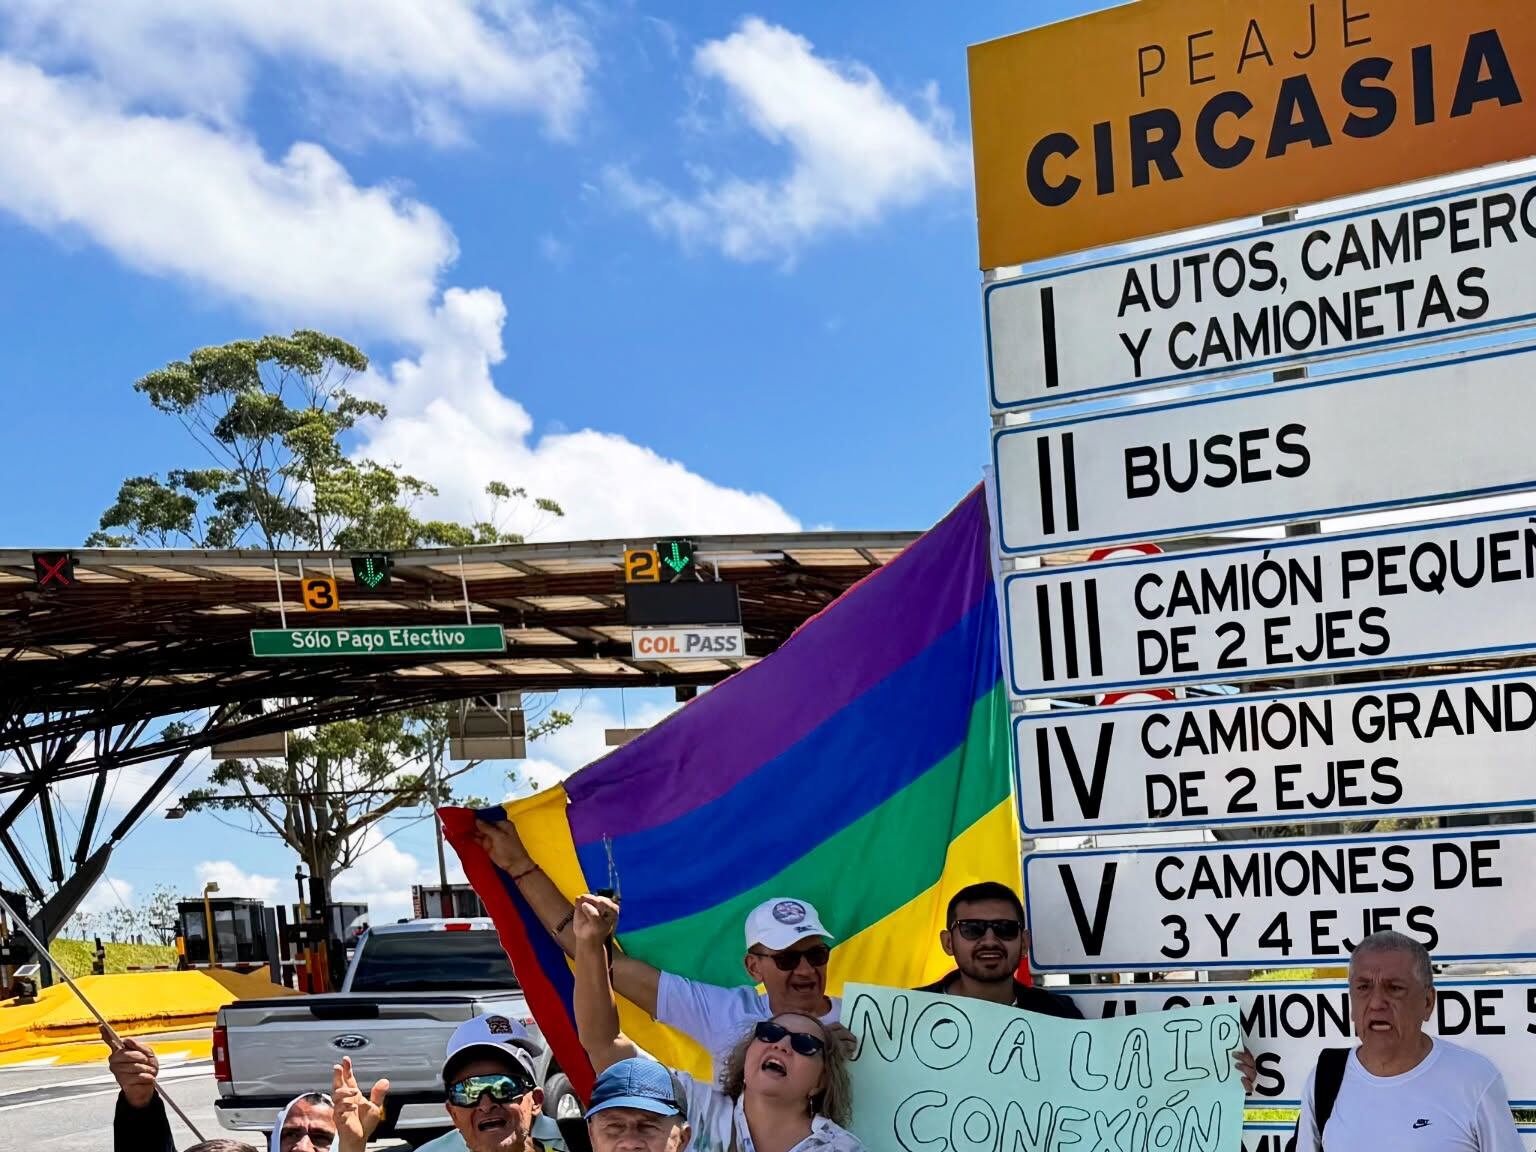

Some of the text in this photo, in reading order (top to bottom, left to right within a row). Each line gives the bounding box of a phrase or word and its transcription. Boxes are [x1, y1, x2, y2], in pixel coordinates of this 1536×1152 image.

[1138, 0, 1371, 97] PEAJE
[1026, 29, 1522, 207] CIRCASIA
[1118, 241, 1287, 318] AUTOS,
[1119, 266, 1490, 378] Y CAMIONETAS
[1124, 423, 1312, 500] BUSES
[307, 580, 334, 609] 3
[629, 552, 655, 580] 2
[1134, 550, 1323, 620] CAMIÓN
[291, 629, 465, 652] Sólo Pago Efectivo
[638, 633, 737, 654] COL PASS
[1137, 606, 1391, 676] DE 2 EJES
[1035, 721, 1115, 823] IV
[1145, 756, 1404, 819] DE 2 EJES
[1155, 840, 1503, 900] CAMIONES DE
[1058, 861, 1118, 957] V
[1160, 914, 1190, 959] 3
[1205, 912, 1241, 958] Y
[1258, 911, 1292, 957] 4
[851, 993, 973, 1070] NO
[988, 1017, 1040, 1083] A
[1069, 1027, 1153, 1092] LA
[1436, 989, 1506, 1035] DE
